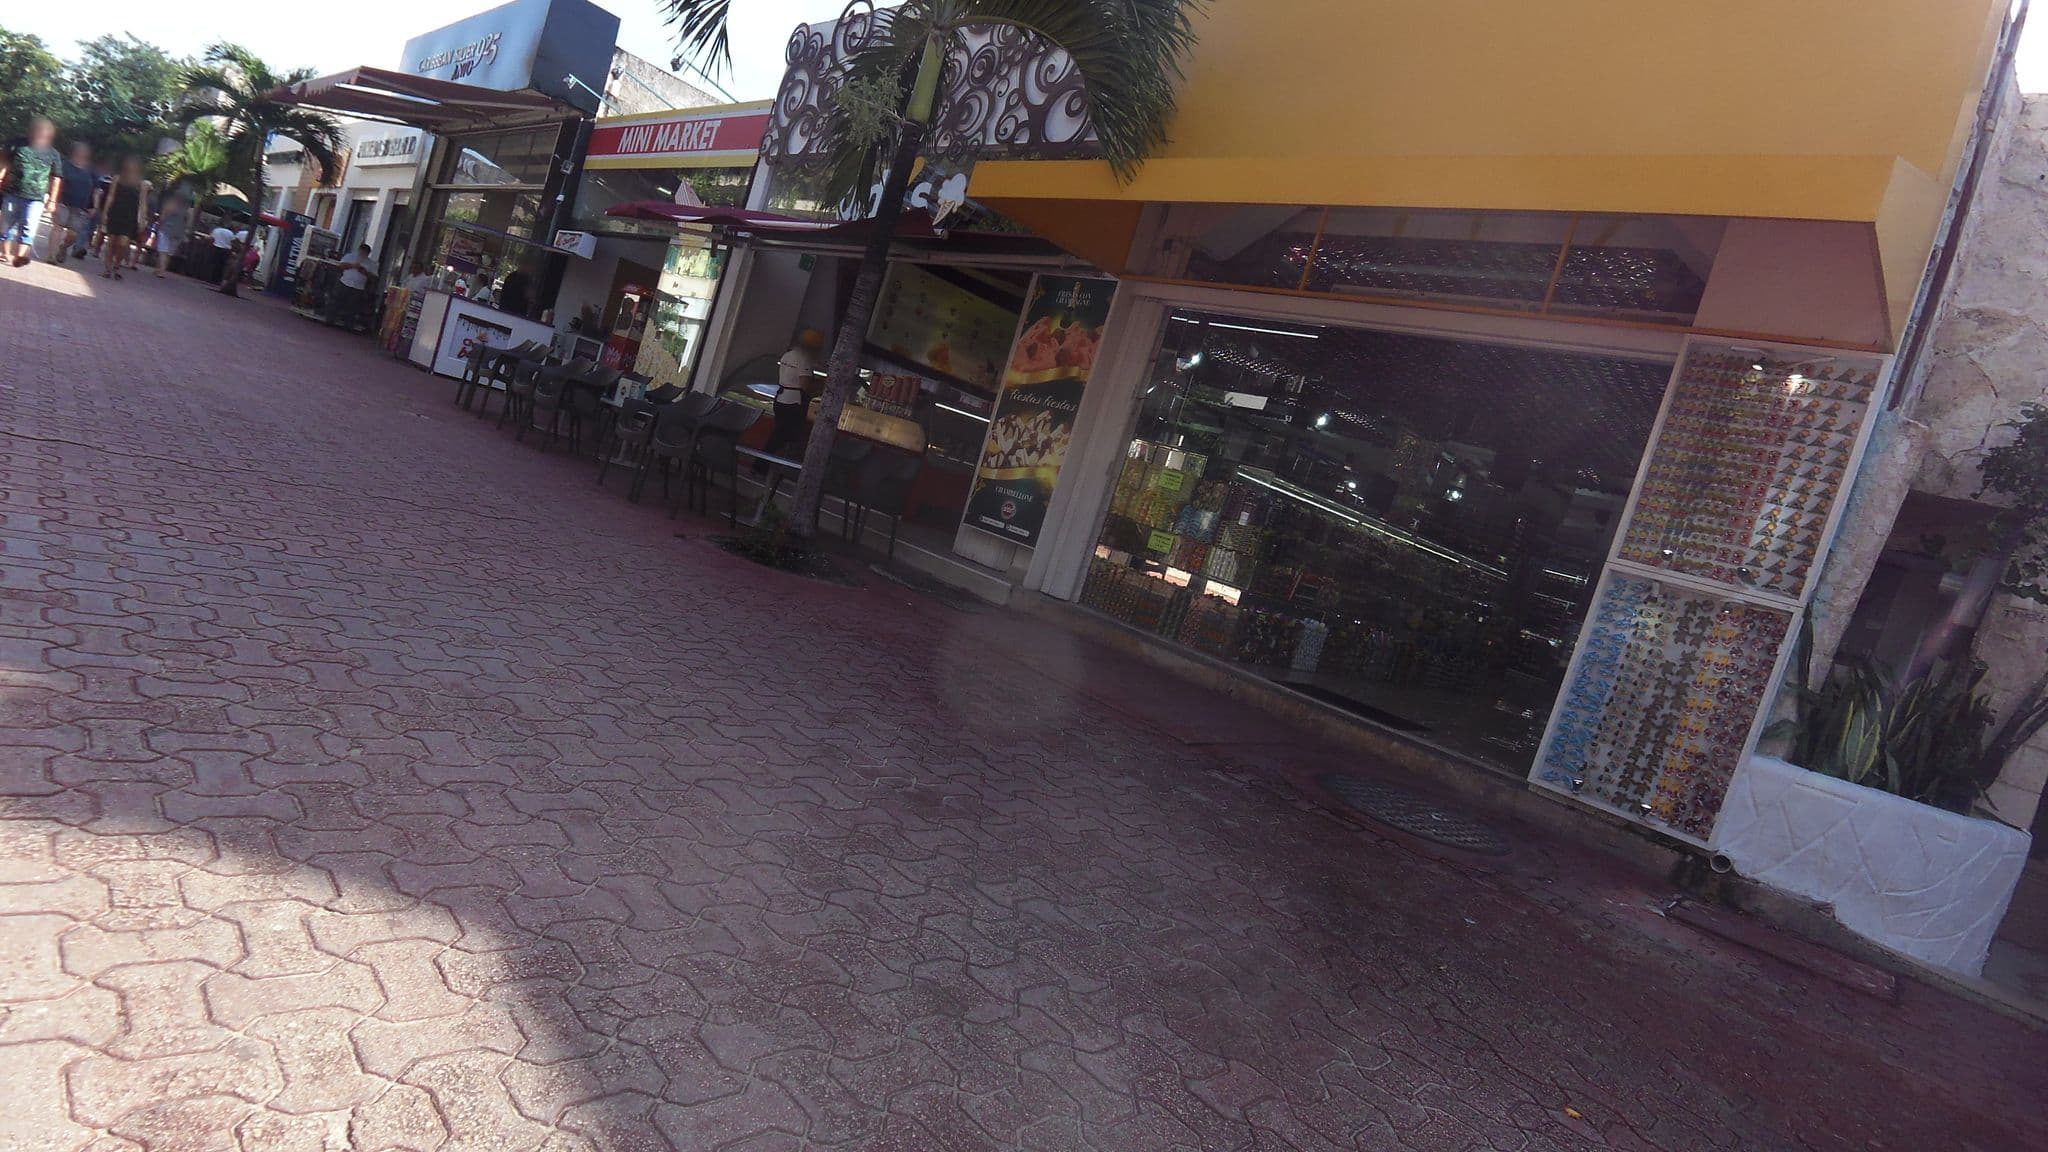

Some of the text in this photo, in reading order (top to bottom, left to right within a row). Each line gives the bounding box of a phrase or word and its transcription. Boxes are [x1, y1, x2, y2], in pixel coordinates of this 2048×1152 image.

[417, 31, 503, 73] CARIBBEAN SILVER 925
[617, 120, 722, 153] MINI MARKET
